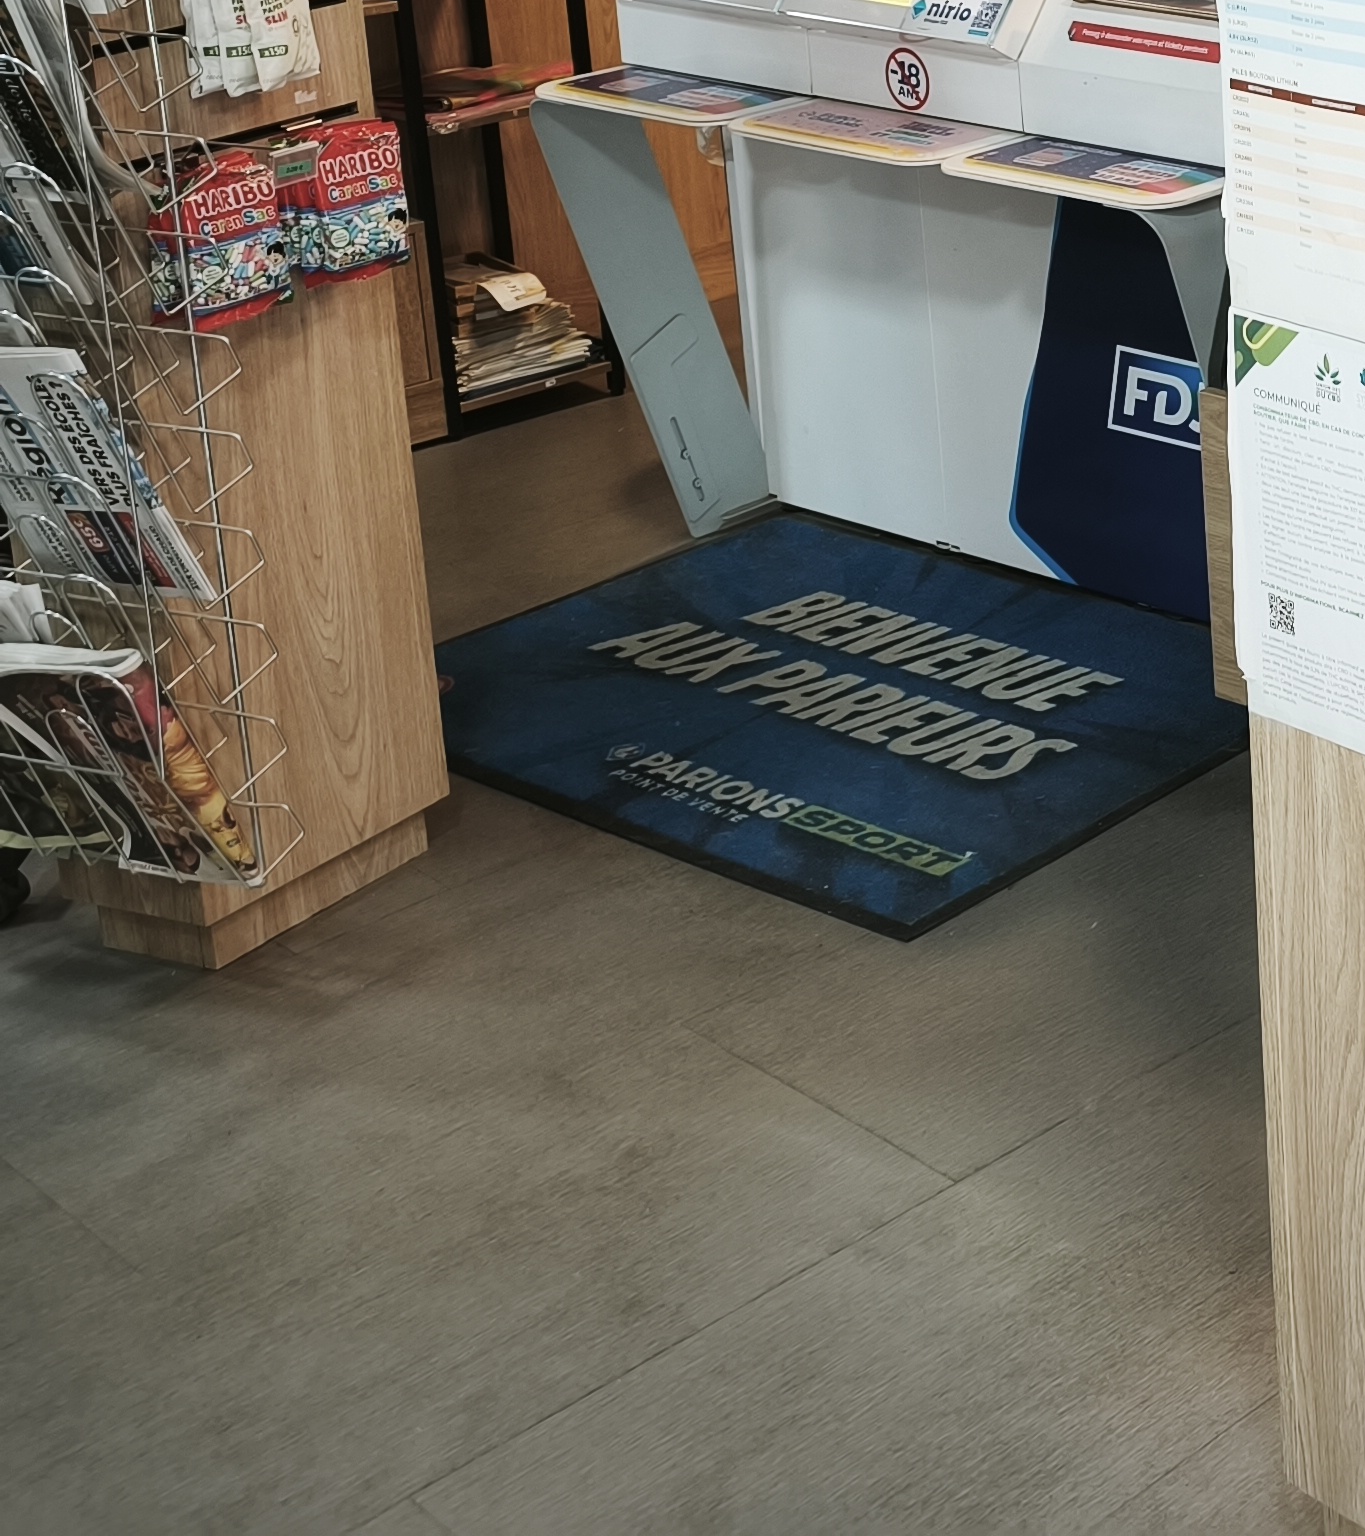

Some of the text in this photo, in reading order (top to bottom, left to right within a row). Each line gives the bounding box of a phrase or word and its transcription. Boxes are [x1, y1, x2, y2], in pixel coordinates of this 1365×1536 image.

[927, 0, 972, 22] nirio
[320, 146, 399, 184] HARIBO
[192, 180, 276, 218] HARIBO
[1253, 386, 1322, 416] COMMUNIQUÉ
[741, 589, 1126, 713] BIENVENUE
[586, 620, 1079, 783] AUX PARIEURS
